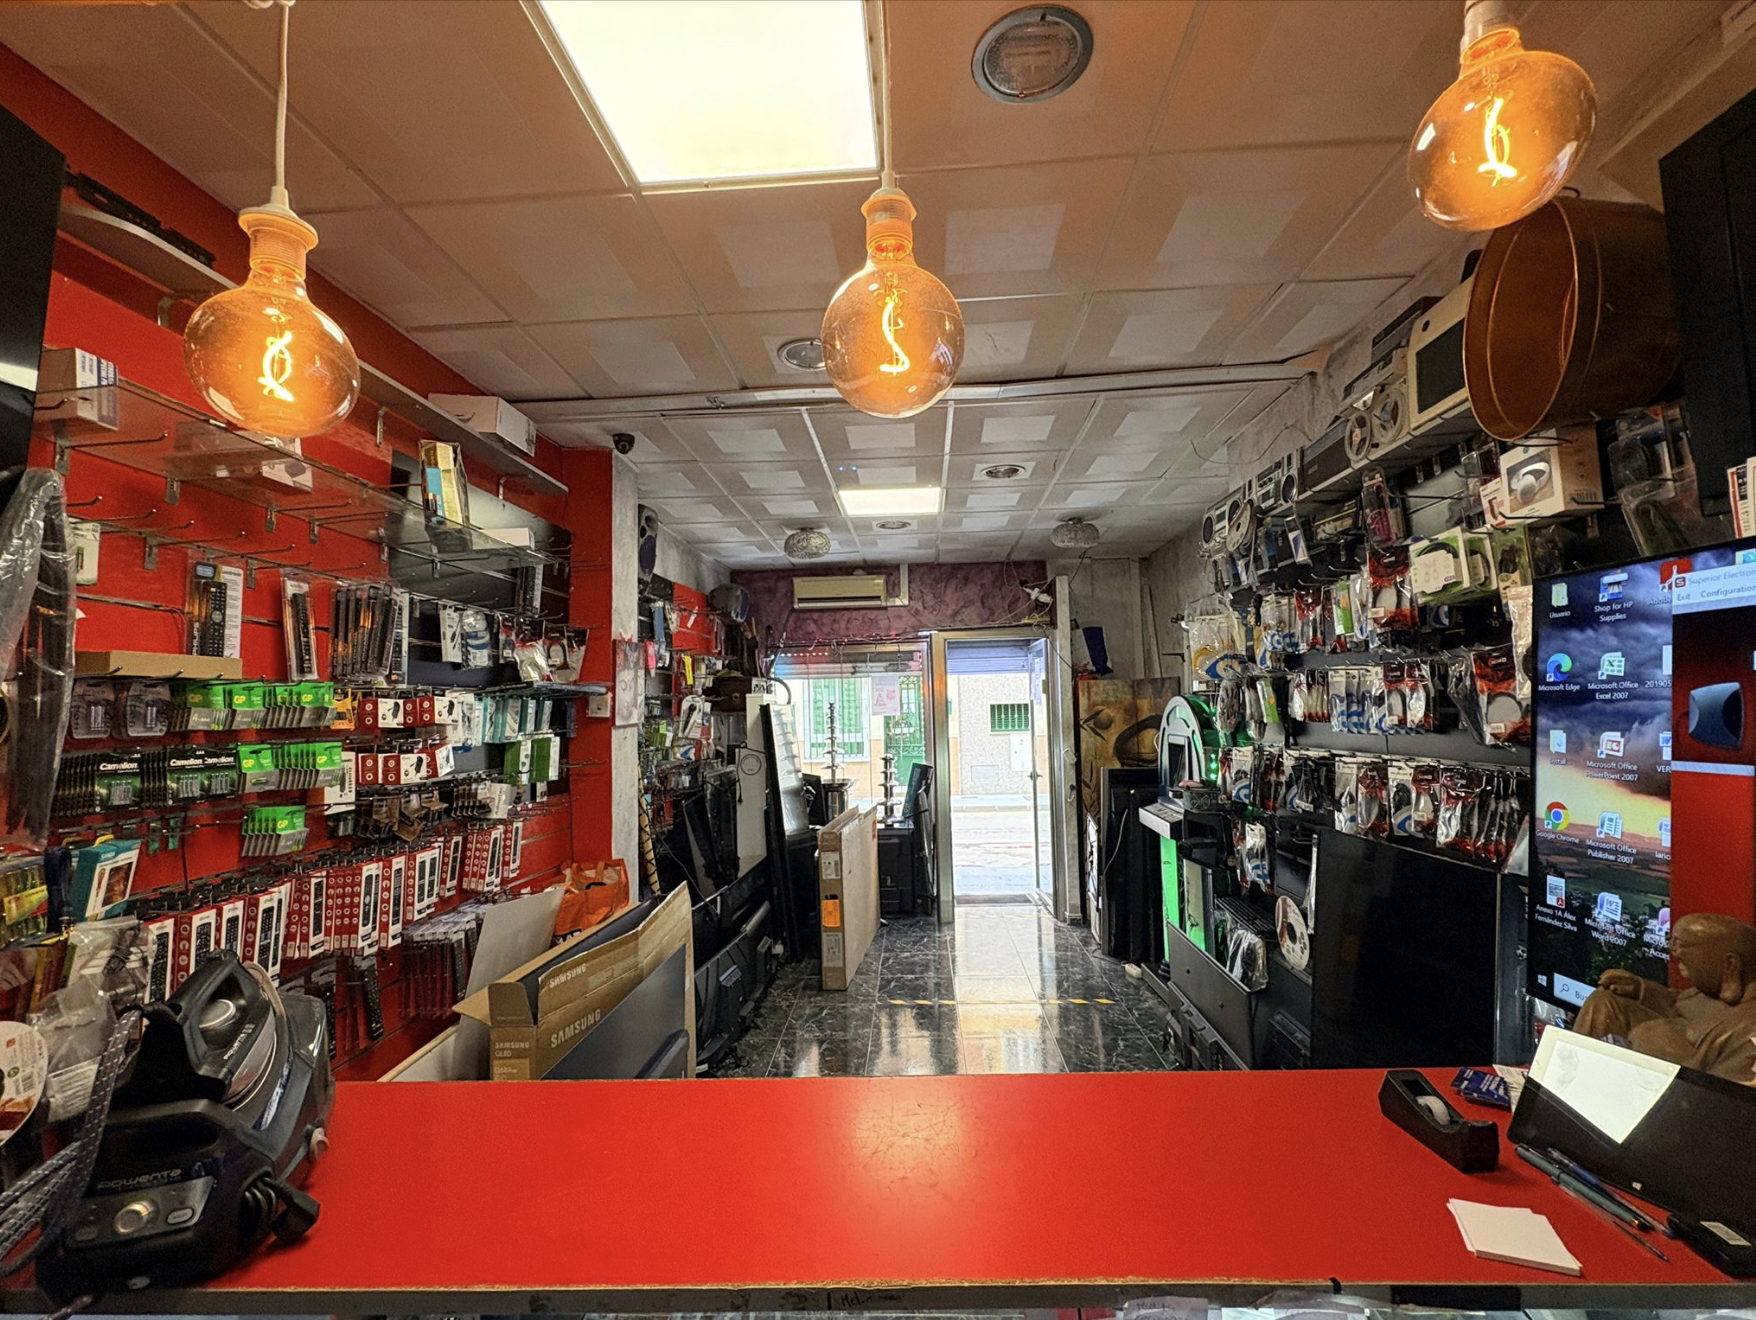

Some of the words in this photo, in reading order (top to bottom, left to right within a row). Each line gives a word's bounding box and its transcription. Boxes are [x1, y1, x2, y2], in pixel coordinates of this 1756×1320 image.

[1594, 604, 1611, 613] Shop
[1623, 601, 1633, 609] HP
[1549, 610, 1571, 619] Usuario
[1600, 613, 1627, 622] Supplies
[1565, 684, 1580, 692] Edge
[1596, 692, 1611, 700] Excel
[100, 761, 138, 771] Camelion
[170, 758, 203, 767] Camelion
[1586, 760, 1616, 769] Microsoft
[1586, 771, 1621, 779] PowerPoint
[1621, 773, 1639, 781] 2007
[1535, 829, 1556, 839] Google
[1556, 833, 1580, 844] Chrome
[1586, 838, 1616, 850] Microsoft
[1617, 844, 1637, 854] Office
[1587, 849, 1616, 861] Publisher
[1617, 855, 1635, 864] 2007
[1563, 922, 1578, 932] Silva
[1584, 917, 1615, 932] Microsoft
[1615, 923, 1636, 939] Office
[1610, 935, 1628, 947] 2007
[549, 963, 587, 988] SAMSUNG
[550, 1008, 601, 1048] SAMSUNG
[495, 1041, 530, 1049] SAMSUNG
